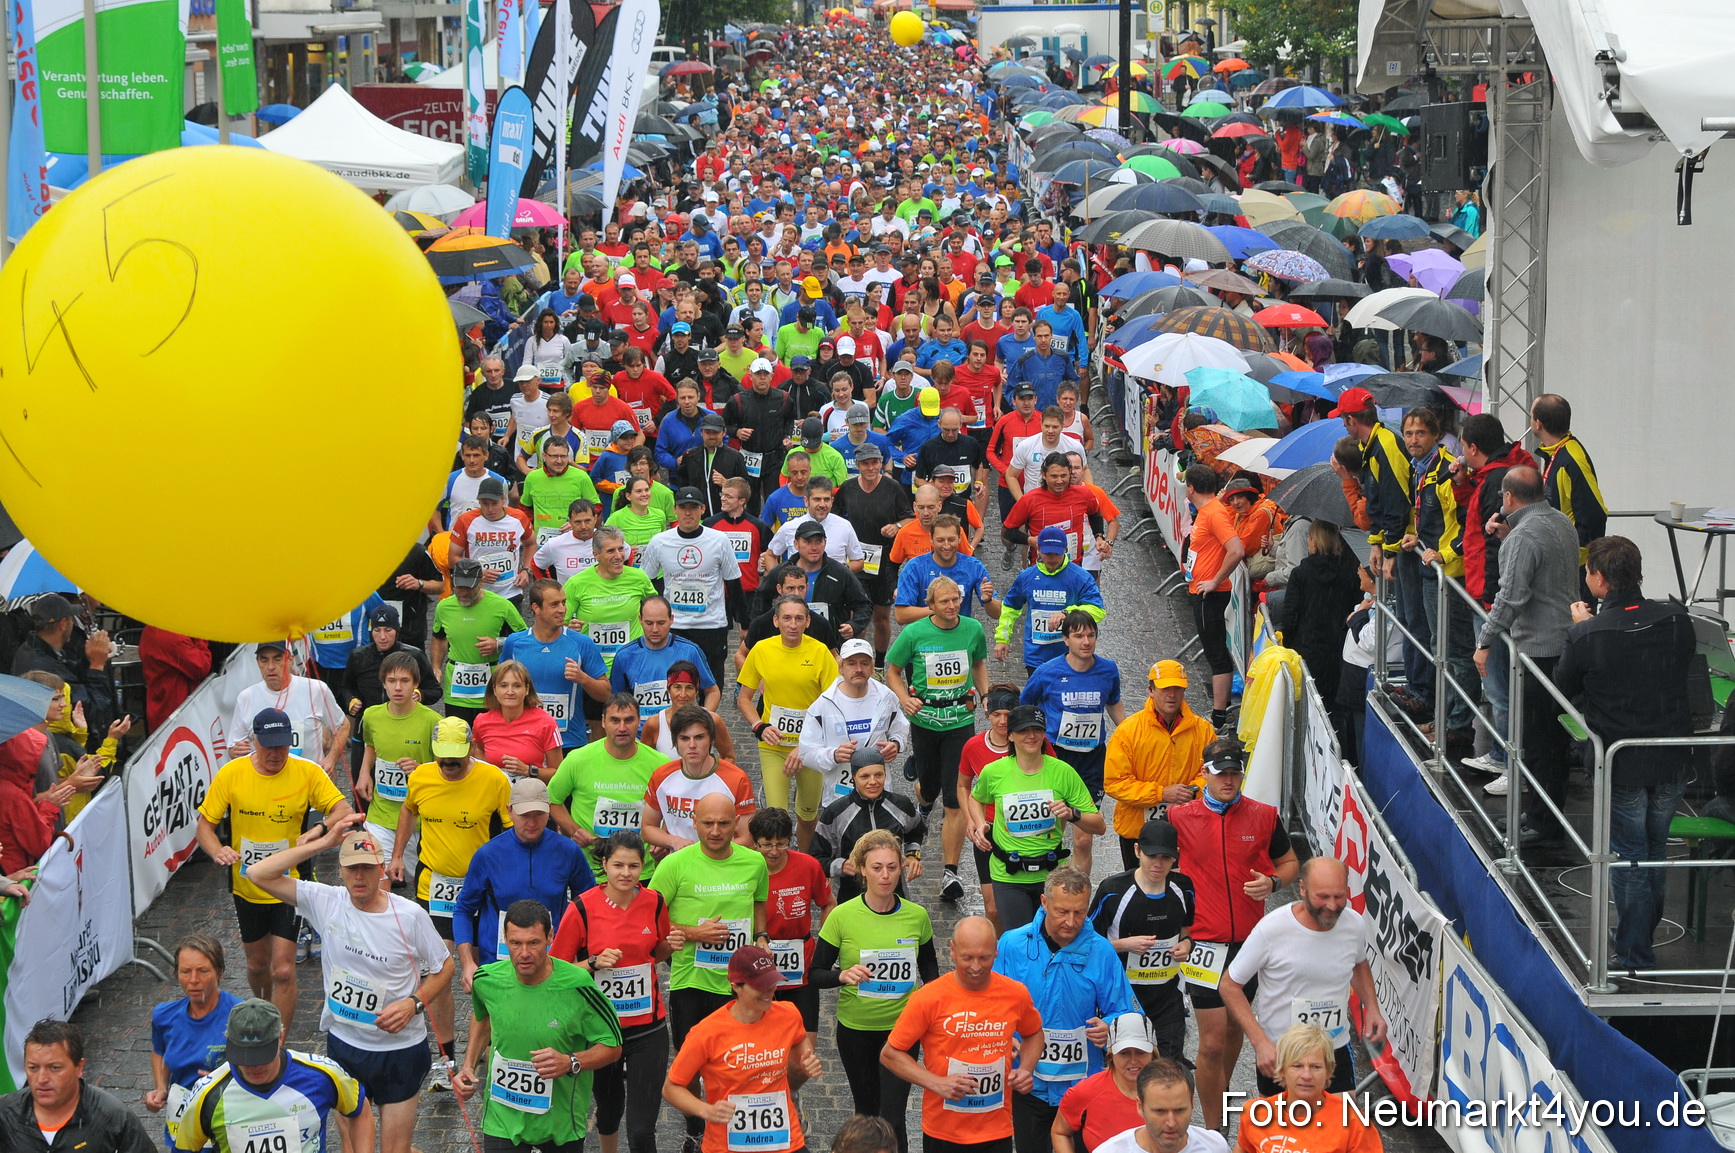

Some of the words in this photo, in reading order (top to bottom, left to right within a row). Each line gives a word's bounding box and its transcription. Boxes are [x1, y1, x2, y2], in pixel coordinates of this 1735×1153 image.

[131, 72, 168, 83] leben.
[100, 88, 154, 100] schaffen.
[612, 112, 628, 161] Audi
[623, 67, 635, 109] BKK
[502, 120, 525, 142] maxi
[539, 368, 559, 377] 2697
[475, 531, 516, 541] MERZ
[673, 591, 704, 605] 2448
[1033, 589, 1067, 599] HUBER
[593, 630, 627, 644] 3109
[935, 661, 961, 676] 369
[455, 671, 488, 685] 3364
[636, 690, 671, 706] 2254
[1061, 691, 1101, 702] HUBER
[777, 716, 803, 733] 668
[1063, 722, 1097, 738] 2172
[1065, 739, 1091, 747] Christoph
[378, 769, 412, 786] 272
[239, 809, 265, 817] Norbert
[598, 810, 640, 827] 3314
[1009, 802, 1050, 821] 2236
[1019, 822, 1043, 831] Andrea
[710, 954, 731, 963] Helm
[1139, 951, 1172, 968] 626
[866, 962, 911, 981] 2208
[1137, 970, 1168, 979] Matthias
[1185, 966, 1203, 978] Oliver
[600, 977, 646, 999] 2341
[877, 982, 896, 992] Julia
[331, 981, 378, 1011] 2319
[339, 1006, 359, 1020] Horst
[955, 1020, 1008, 1033] Fischer
[960, 1030, 1004, 1039] AUTOMOBILE
[735, 1047, 786, 1064] Fischer
[741, 1057, 784, 1071] AUTOMOBILE
[496, 1067, 546, 1095] 2256
[506, 1092, 532, 1105] Rainer
[967, 1097, 985, 1107] Kurt
[733, 1107, 785, 1131] 3163
[745, 1134, 774, 1145] Andrea
